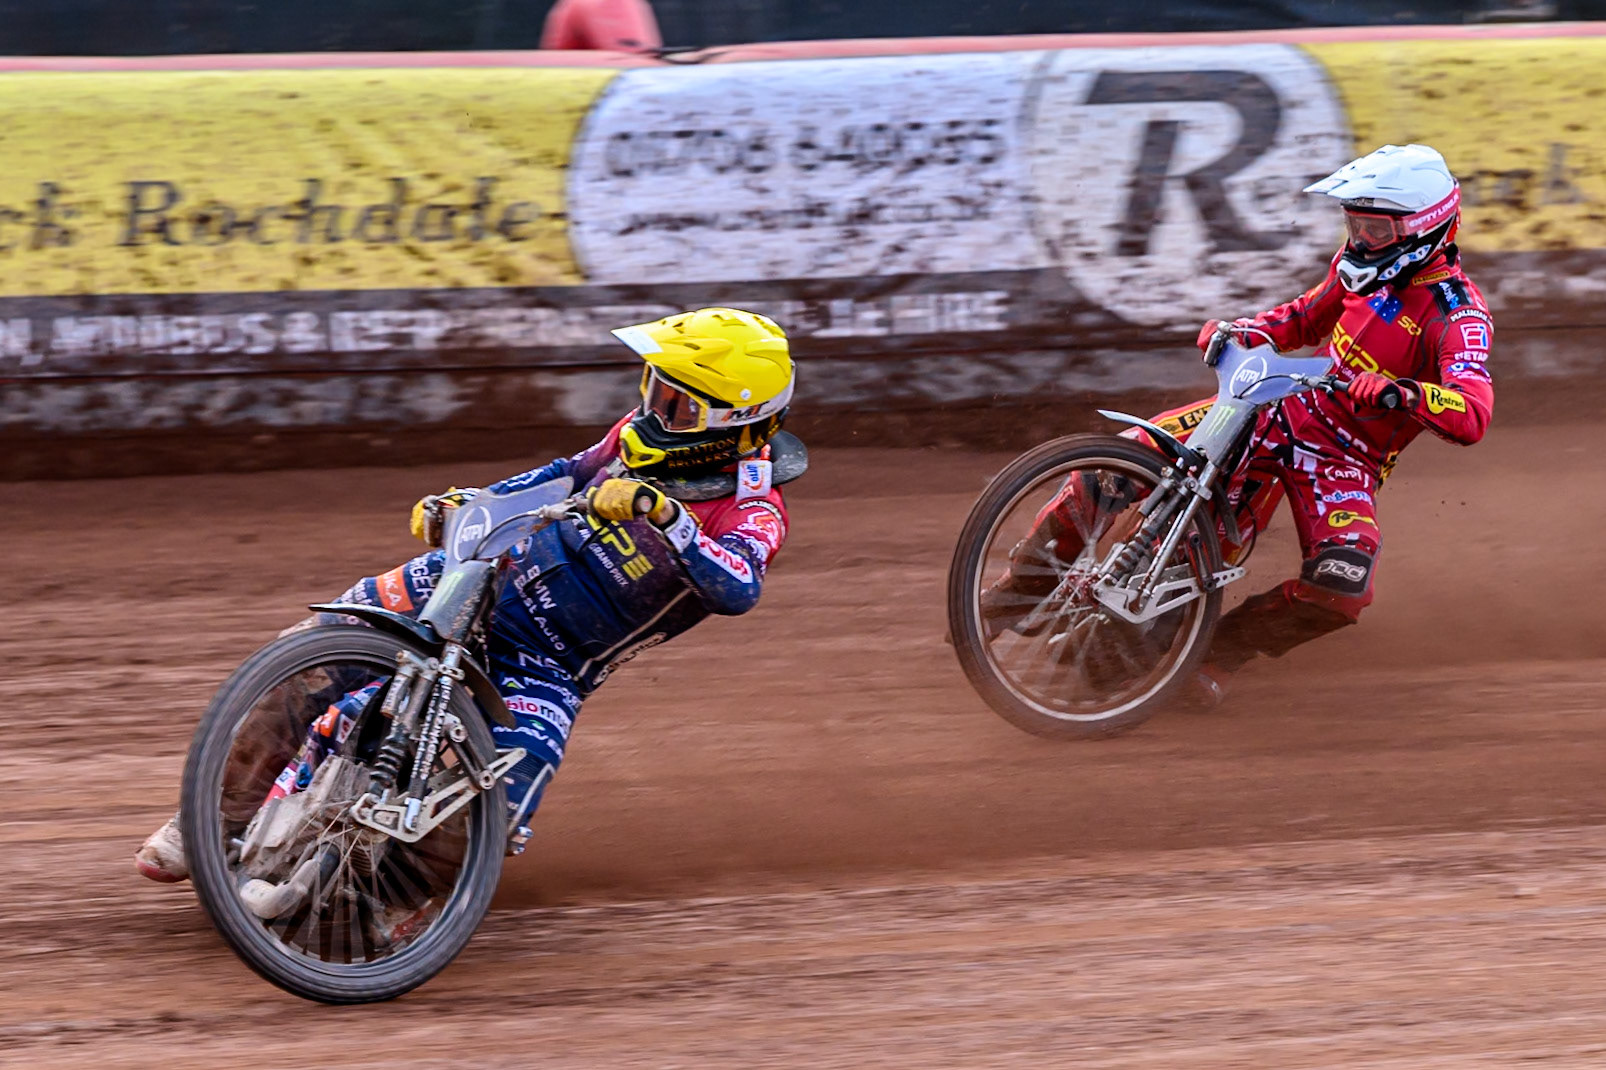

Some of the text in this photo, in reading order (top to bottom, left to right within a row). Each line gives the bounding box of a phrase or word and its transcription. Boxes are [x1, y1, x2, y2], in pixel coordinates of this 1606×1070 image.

[115, 176, 546, 246] Rochdale
[527, 564, 558, 611] BMW
[588, 542, 630, 587] GRAND PRIX
[534, 615, 566, 651] Auto
